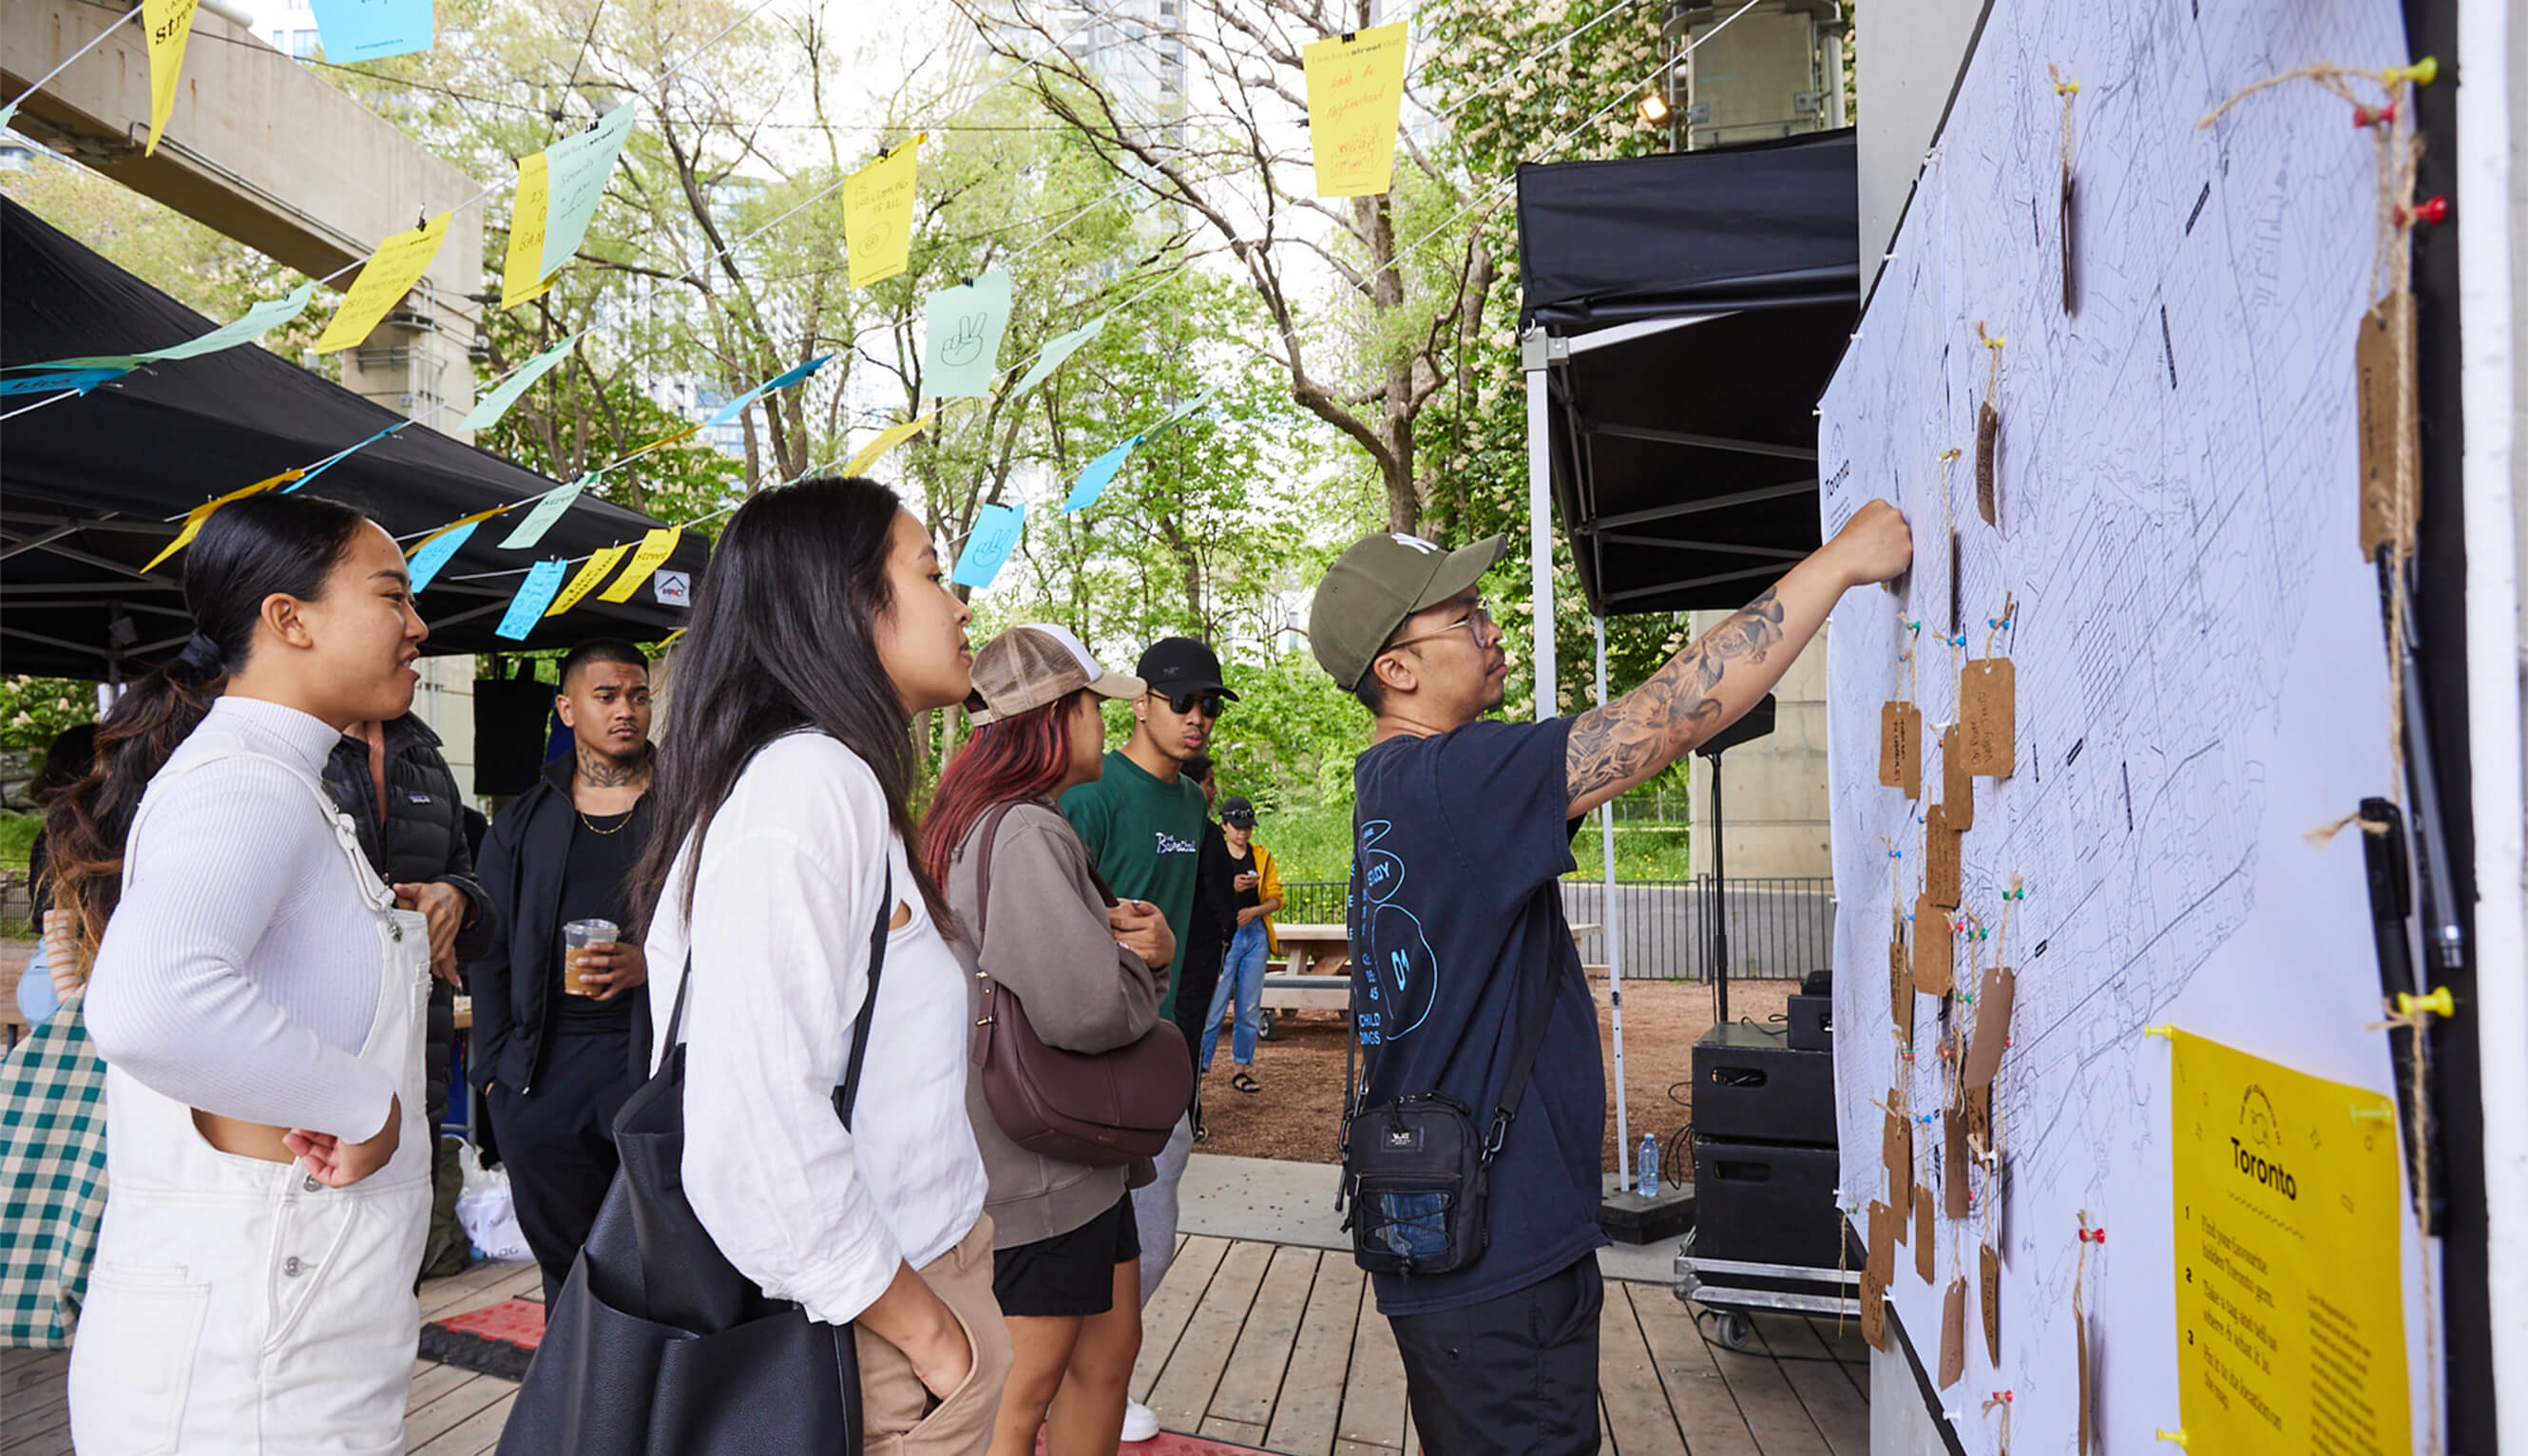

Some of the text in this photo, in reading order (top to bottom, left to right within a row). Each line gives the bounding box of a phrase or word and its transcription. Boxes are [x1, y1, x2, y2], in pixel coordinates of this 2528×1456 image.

[2231, 1136, 2297, 1201] Toronto
[2186, 1206, 2190, 1220] 1
[2186, 1267, 2192, 1283] 2
[2188, 1329, 2194, 1346] 3
